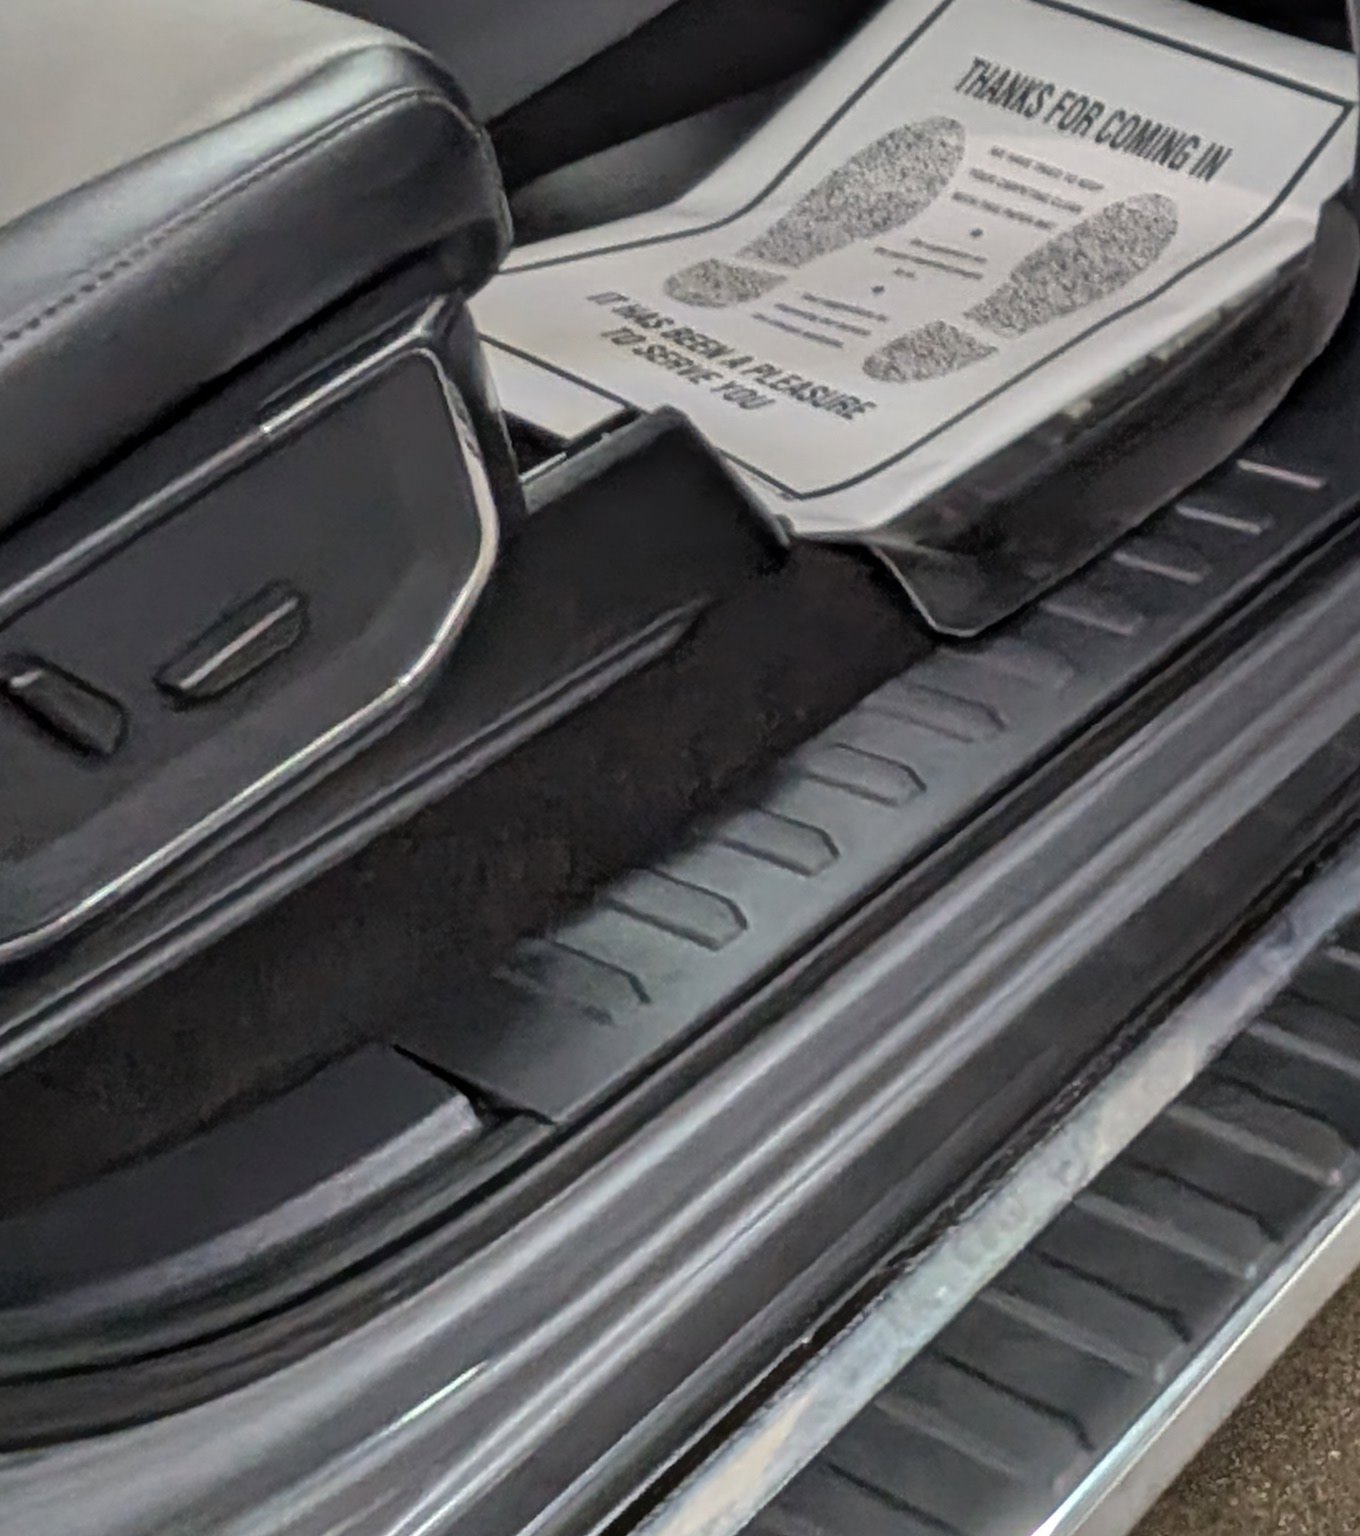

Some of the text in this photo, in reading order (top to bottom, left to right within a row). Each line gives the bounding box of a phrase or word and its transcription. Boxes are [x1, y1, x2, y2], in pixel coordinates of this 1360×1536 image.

[954, 56, 1056, 119] THANKS
[1043, 89, 1105, 137] FOR
[1094, 109, 1201, 171] COMING
[1188, 142, 1234, 182] IN
[586, 291, 630, 306] IT
[611, 303, 675, 329] HAS
[660, 327, 736, 359] BEEN
[719, 356, 754, 369] A
[741, 363, 878, 420] PLEASURE
[601, 326, 777, 411] TO SERVE YOU
